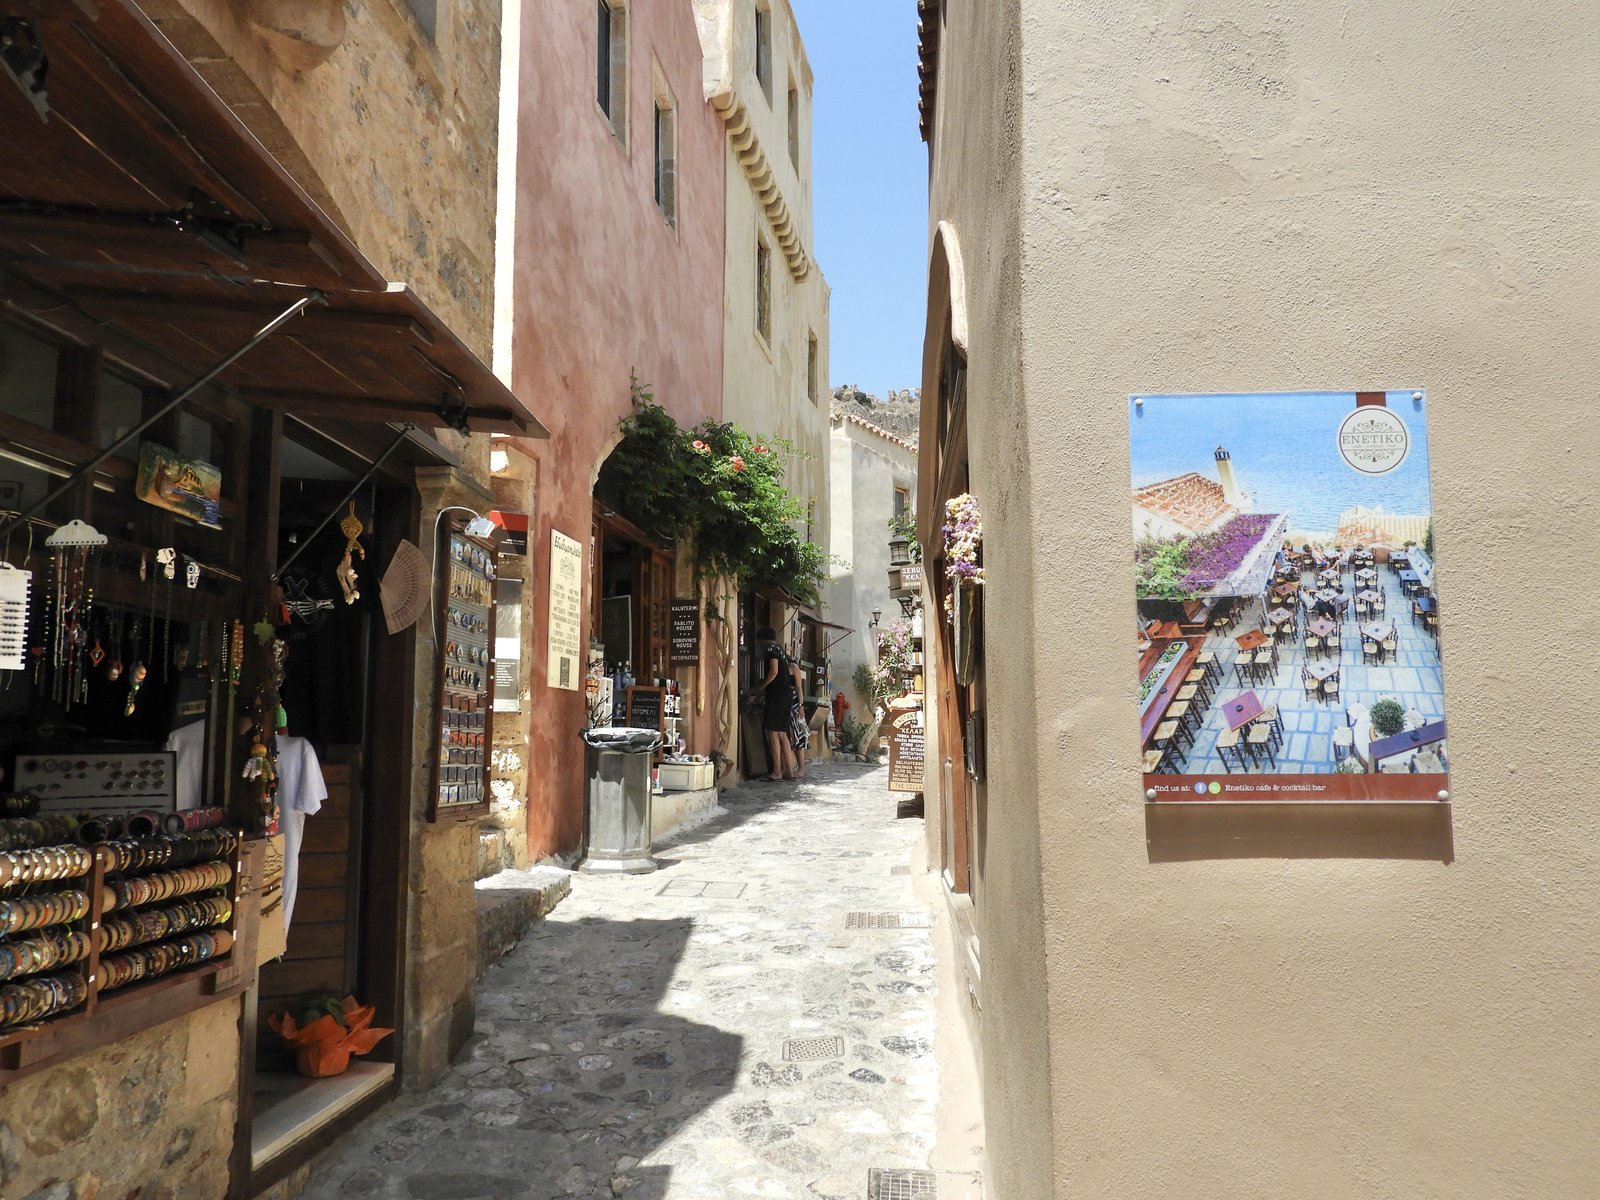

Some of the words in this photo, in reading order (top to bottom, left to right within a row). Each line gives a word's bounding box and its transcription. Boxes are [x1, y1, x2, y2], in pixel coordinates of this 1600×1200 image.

[1342, 434, 1404, 444] ENETIKO
[1154, 784, 1169, 792] find
[1225, 784, 1254, 792] Enetiko
[1255, 784, 1272, 792] cafe
[1272, 784, 1280, 792] &
[1281, 784, 1311, 792] cocktail
[1312, 784, 1326, 792] bar
